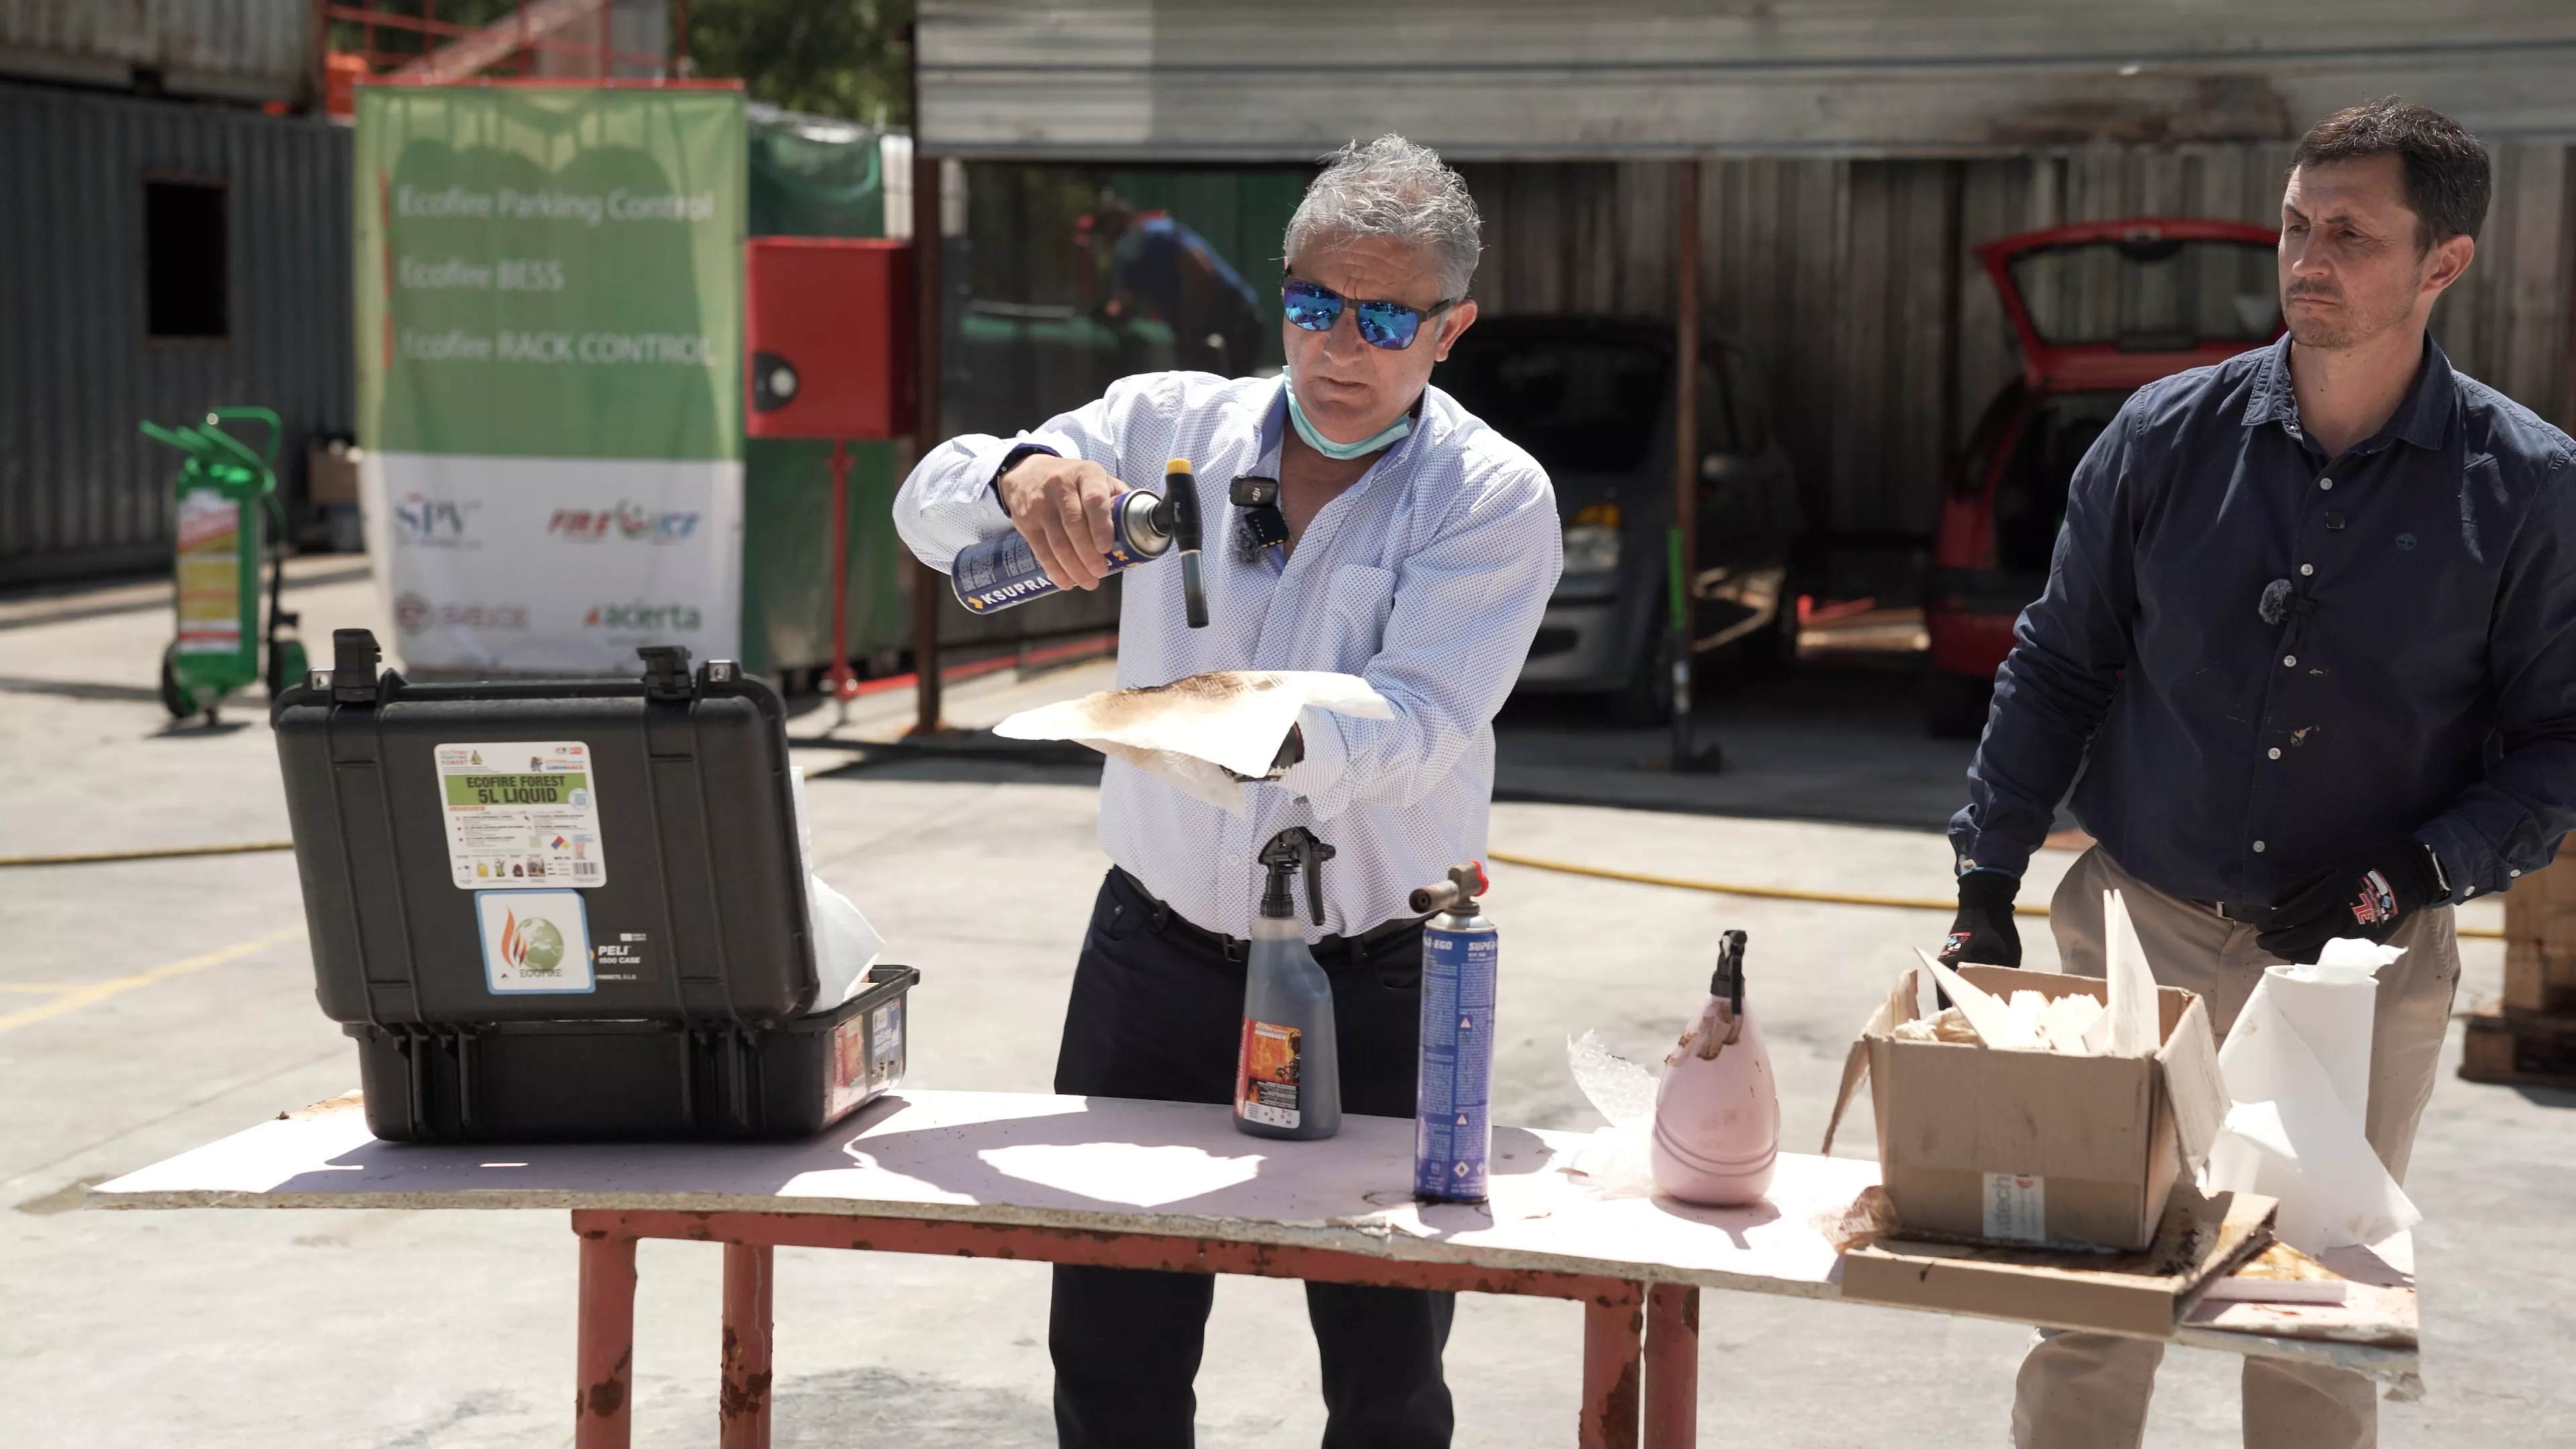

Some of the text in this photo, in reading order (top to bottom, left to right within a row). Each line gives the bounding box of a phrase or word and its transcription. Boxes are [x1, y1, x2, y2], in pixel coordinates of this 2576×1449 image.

[397, 183, 714, 227] Ecofire Parking Control
[398, 256, 565, 291] Ecofire BESS
[401, 328, 718, 366] Ecofire RACK CONTROL
[979, 574, 1054, 605] KSUPRA
[466, 775, 566, 788] ECOFIRE FOREST
[478, 788, 558, 805] 5L LIQUID
[598, 945, 629, 956] PELI
[519, 969, 563, 977] ECOFIRE
